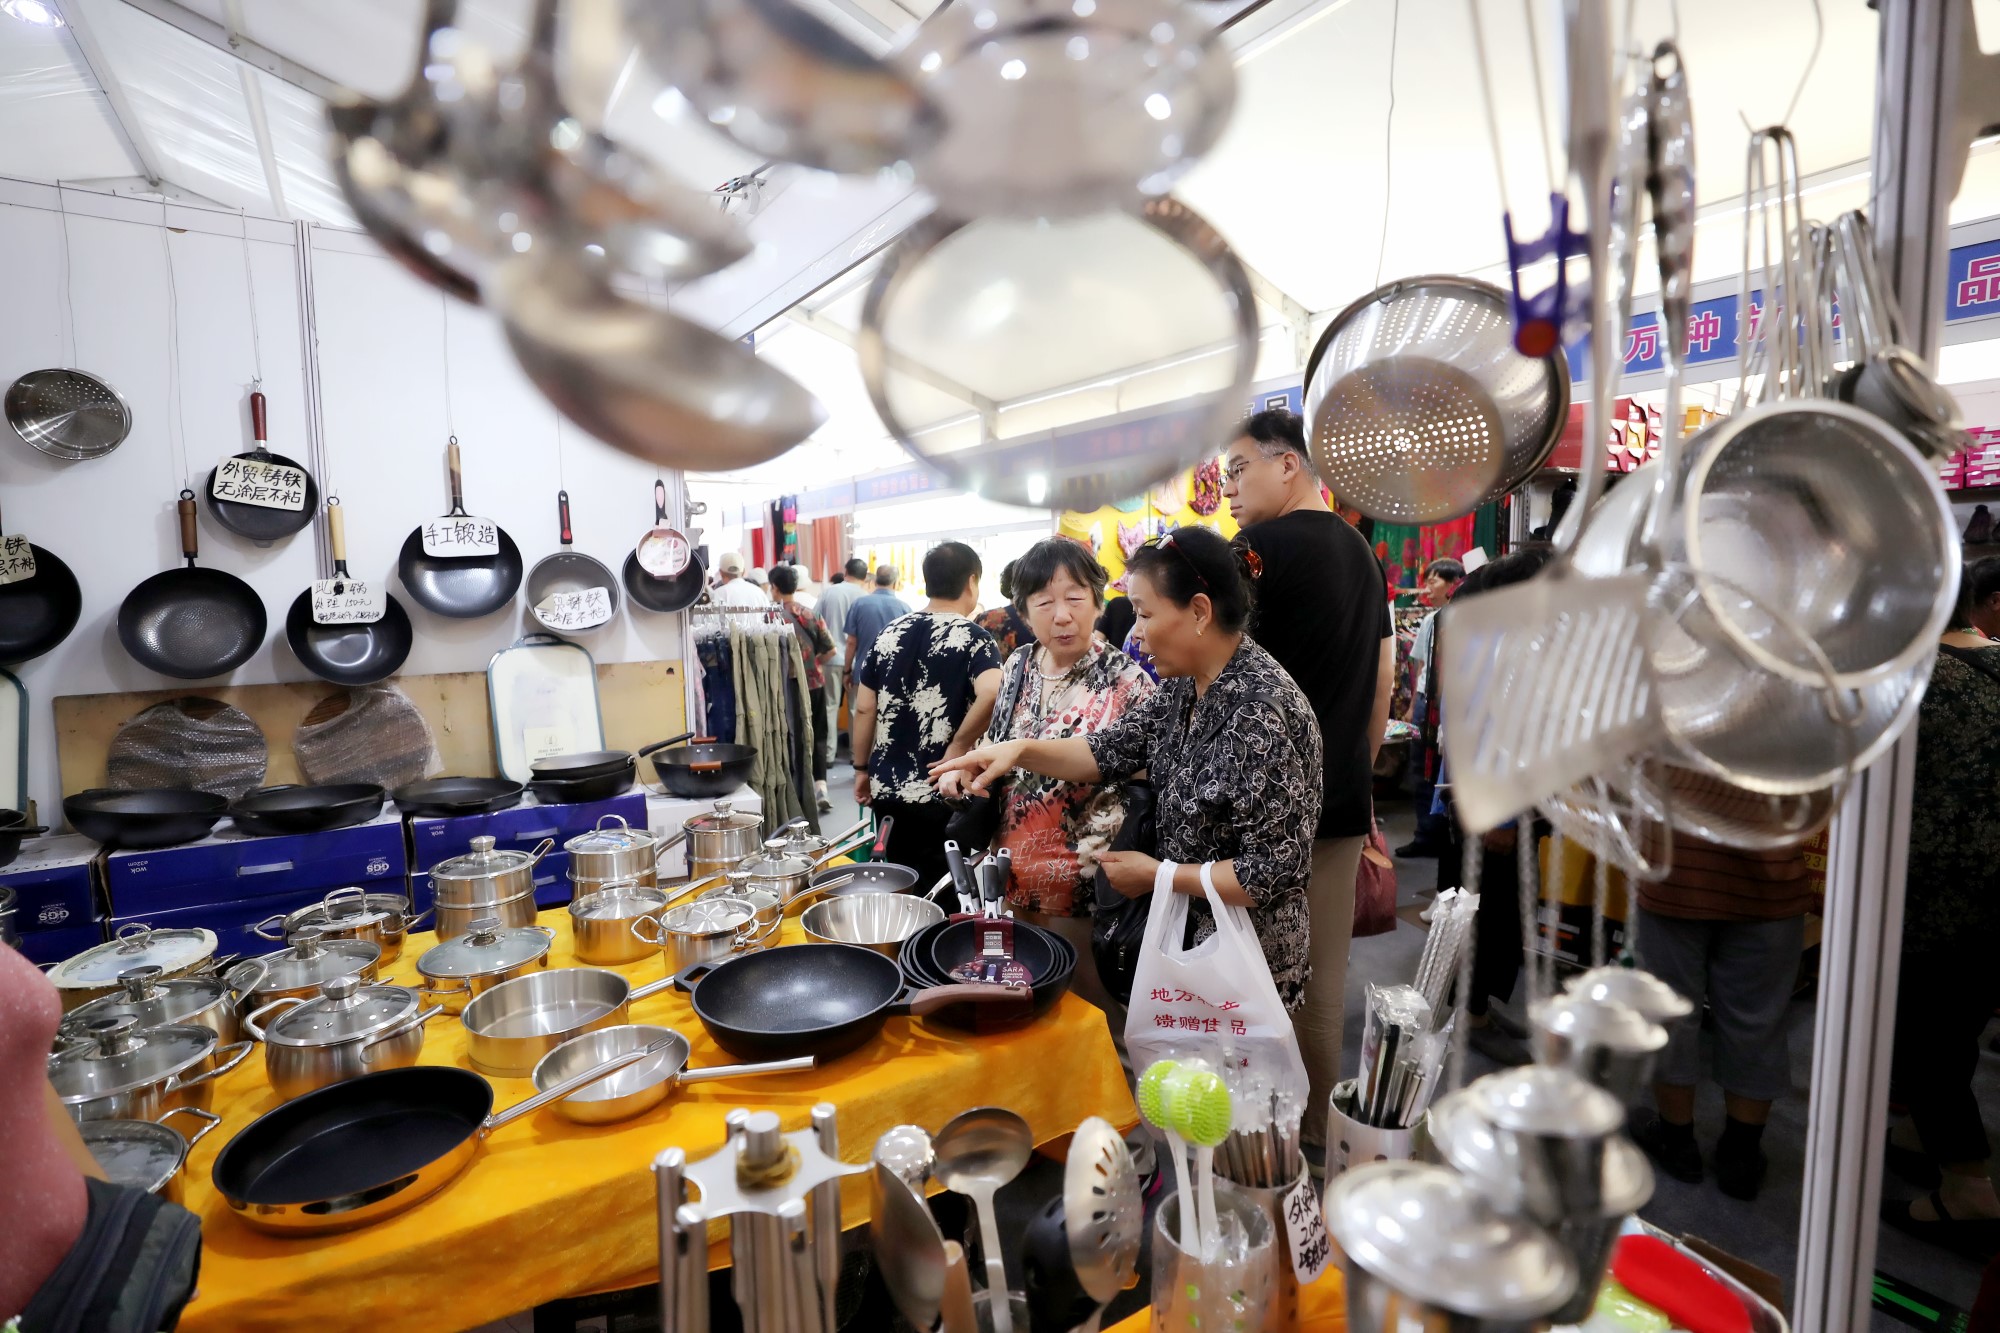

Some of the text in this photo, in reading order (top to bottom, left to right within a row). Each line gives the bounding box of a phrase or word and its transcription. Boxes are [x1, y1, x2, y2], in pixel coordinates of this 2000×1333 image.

[222, 461, 301, 488] 外贸铸铁
[215, 481, 302, 506] 无涂层不粘
[424, 522, 497, 547] 手工锻造
[0, 537, 30, 556] 铁
[366, 862, 390, 873] GGS
[38, 910, 70, 922] GGS
[1150, 988, 1240, 1011] 地方产
[1154, 1014, 1247, 1035] 馈赠佳品
